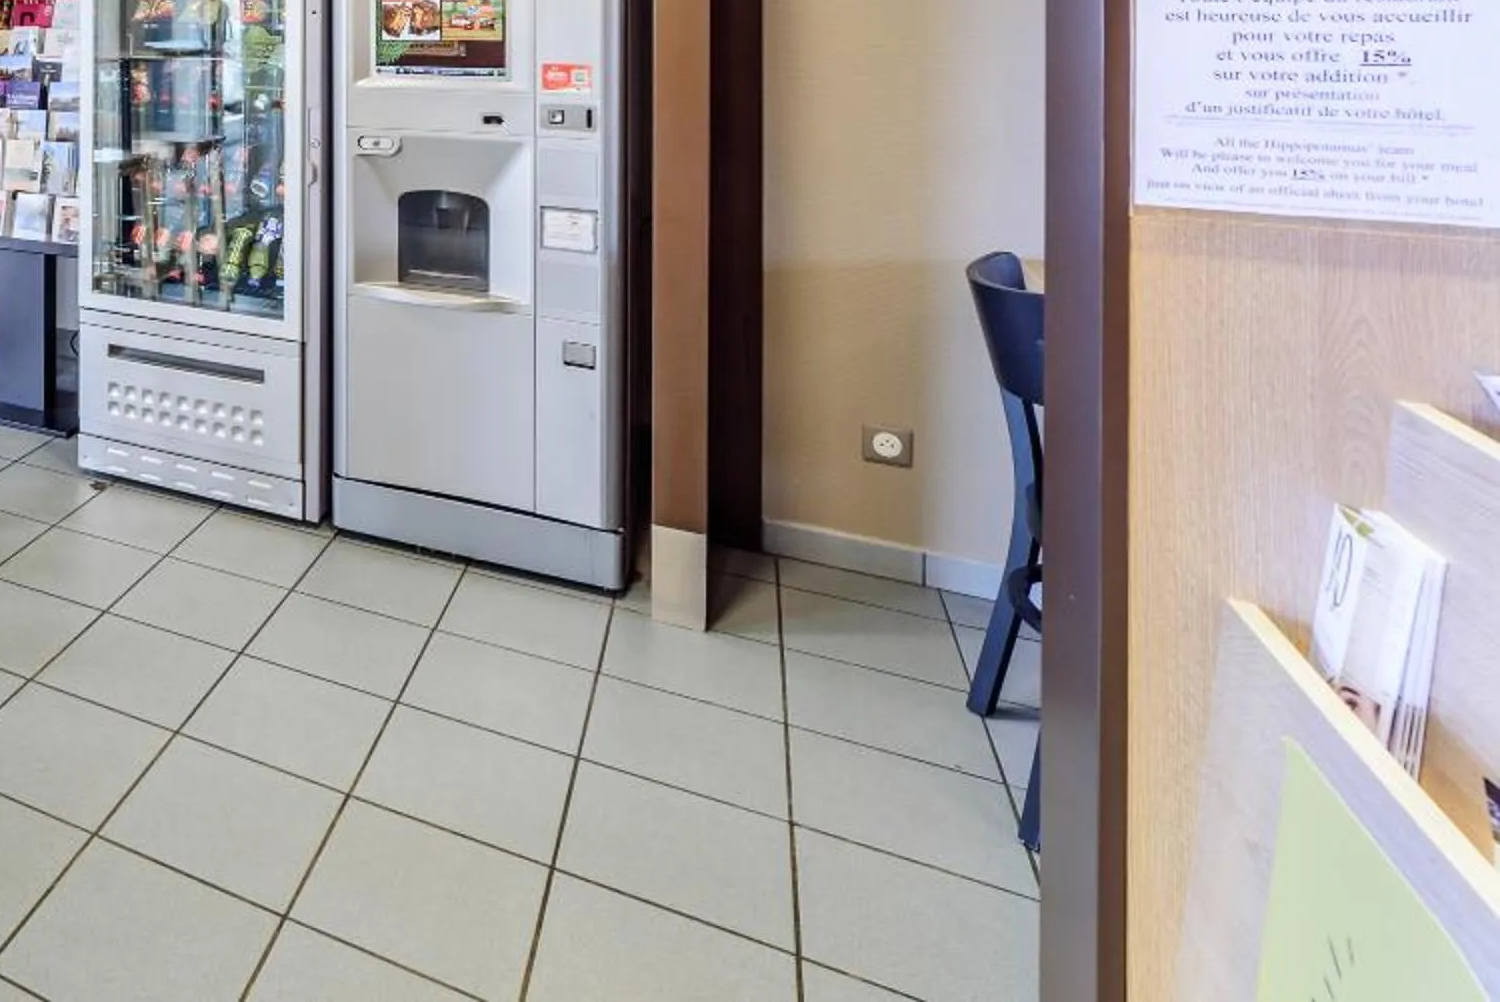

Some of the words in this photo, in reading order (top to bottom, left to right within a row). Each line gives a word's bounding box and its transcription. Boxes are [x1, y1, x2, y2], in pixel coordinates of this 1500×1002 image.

[1165, 10, 1190, 23] est
[1197, 8, 1282, 23] heureuse
[1288, 9, 1311, 23] de
[1318, 11, 1366, 23] vous
[1372, 9, 1473, 23] accueillir
[1232, 31, 1275, 46] pour
[1283, 31, 1334, 44] votre
[1340, 31, 1396, 47] repas
[1216, 49, 1234, 61] et
[1239, 50, 1285, 62] vous
[1291, 49, 1342, 63] offre
[1361, 48, 1413, 65] 15%
[1213, 69, 1242, 81] sur
[1248, 69, 1299, 82] votre
[1304, 69, 1389, 84] addition
[1245, 88, 1269, 99] sur
[1317, 105, 1340, 118] de
[1344, 107, 1391, 120] votre
[1158, 147, 1189, 160] Will
